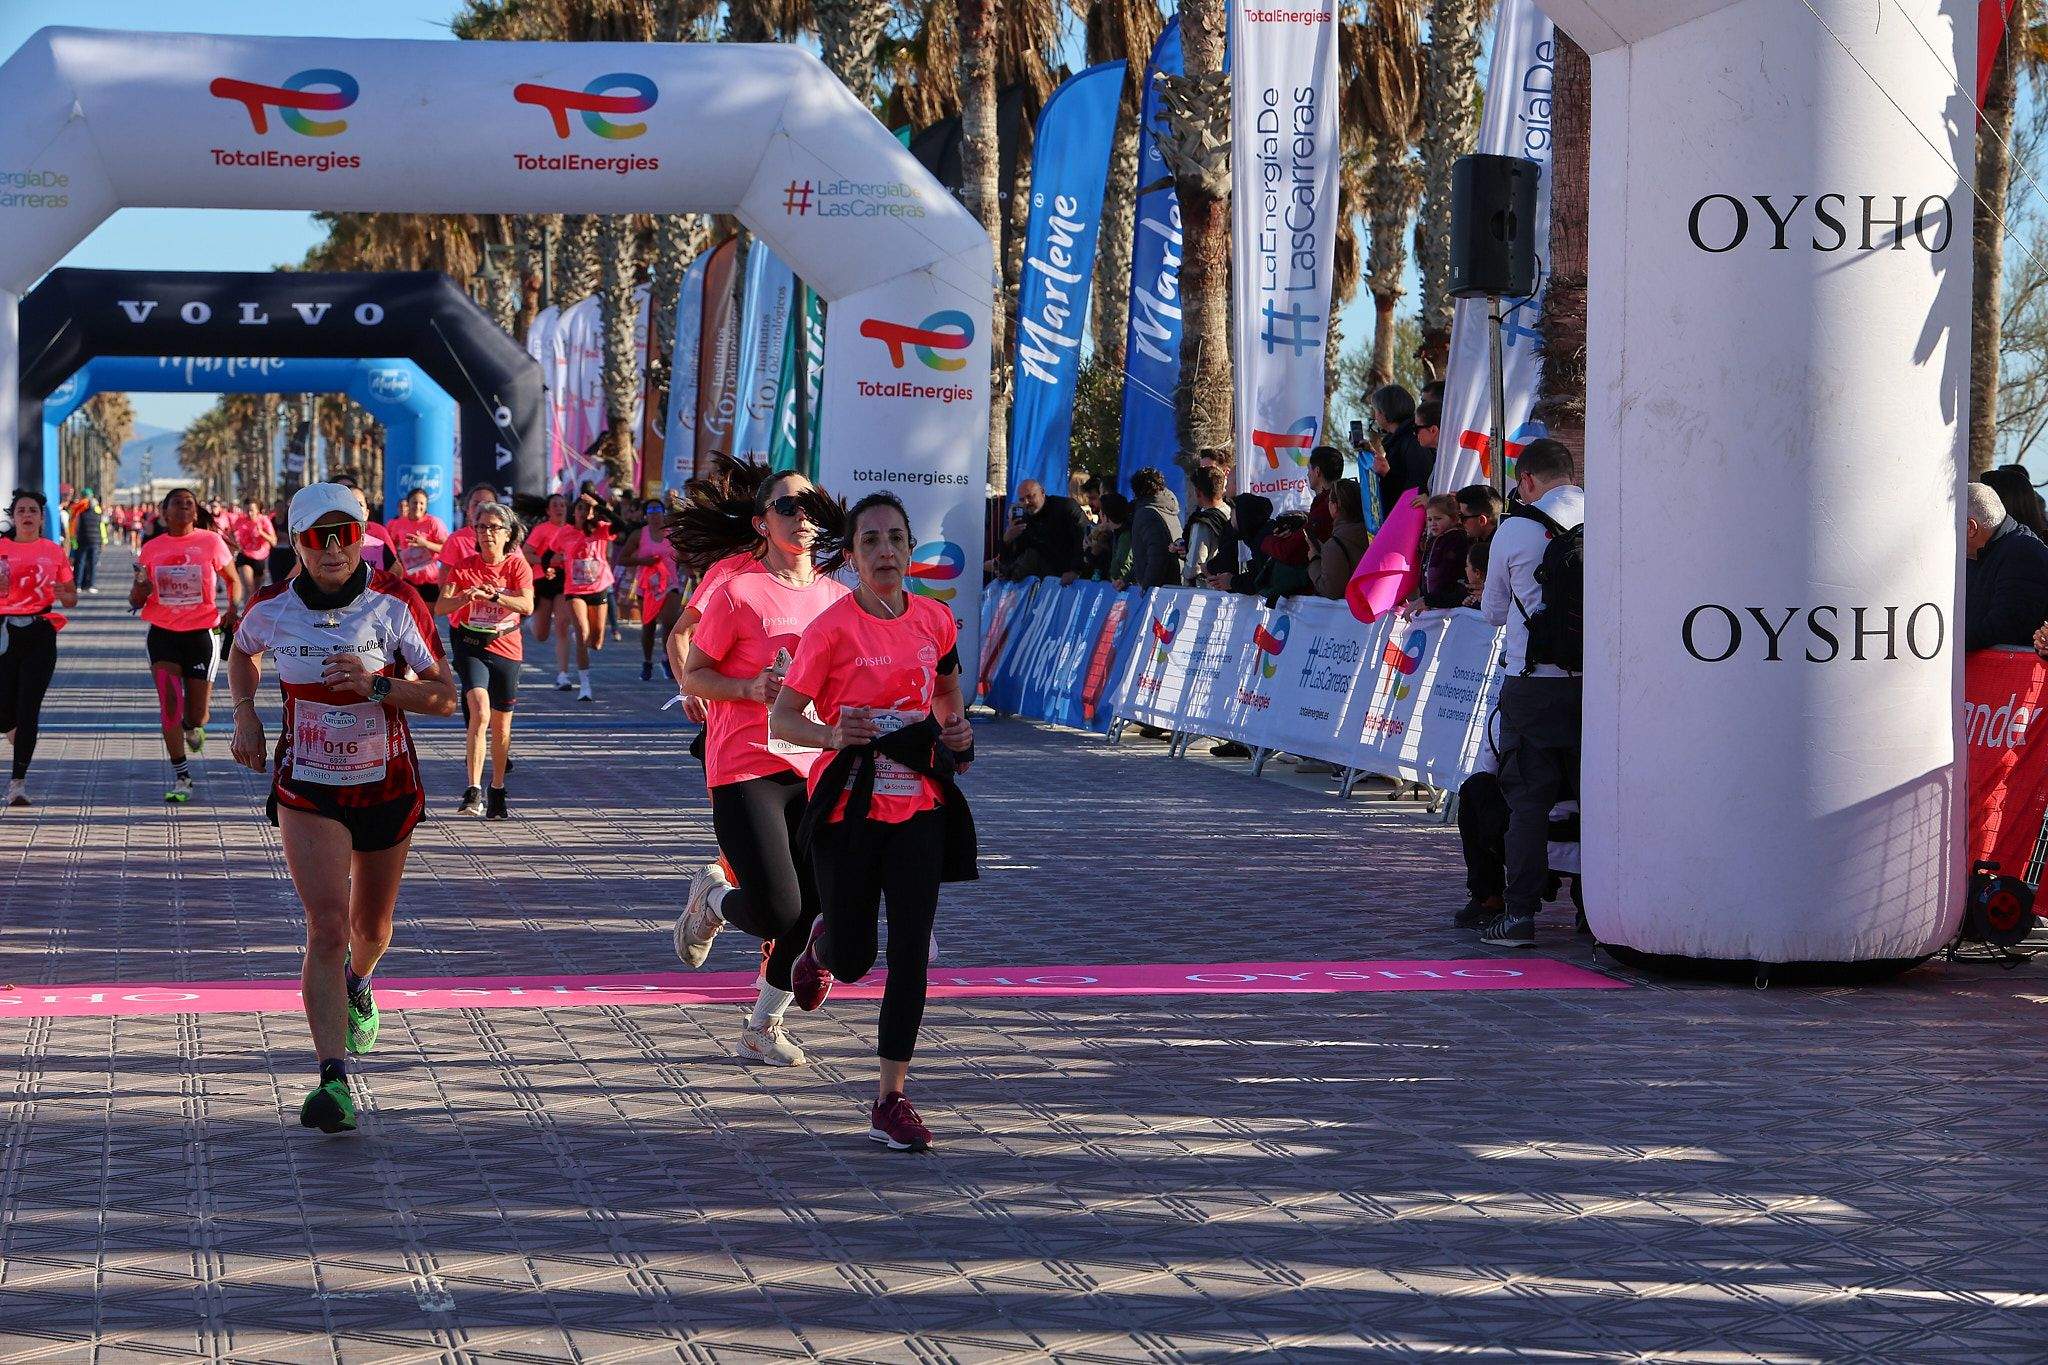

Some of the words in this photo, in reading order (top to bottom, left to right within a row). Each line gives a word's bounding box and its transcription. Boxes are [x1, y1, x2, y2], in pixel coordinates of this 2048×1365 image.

[1245, 9, 1331, 26] TotalEnergies
[211, 149, 361, 172] TotalEnergies
[513, 153, 660, 175] TotalEnergies
[0, 190, 70, 208] arreras
[1256, 87, 1283, 291] LaEnergíaDe
[1284, 86, 1317, 292] LasCarreras
[816, 199, 926, 219] LasCarreras
[1688, 193, 1953, 253] OYSHO
[1019, 195, 1086, 384] Marlene
[117, 300, 385, 326] VOLVO
[857, 381, 973, 403] TotalEnergies
[853, 468, 969, 486] totalenergies.es
[1681, 602, 1945, 664] OYSHO
[854, 655, 893, 667] OYSHO
[323, 740, 359, 755] 016
[304, 768, 331, 780] OYSHO
[1185, 969, 1524, 983] OYSHO
